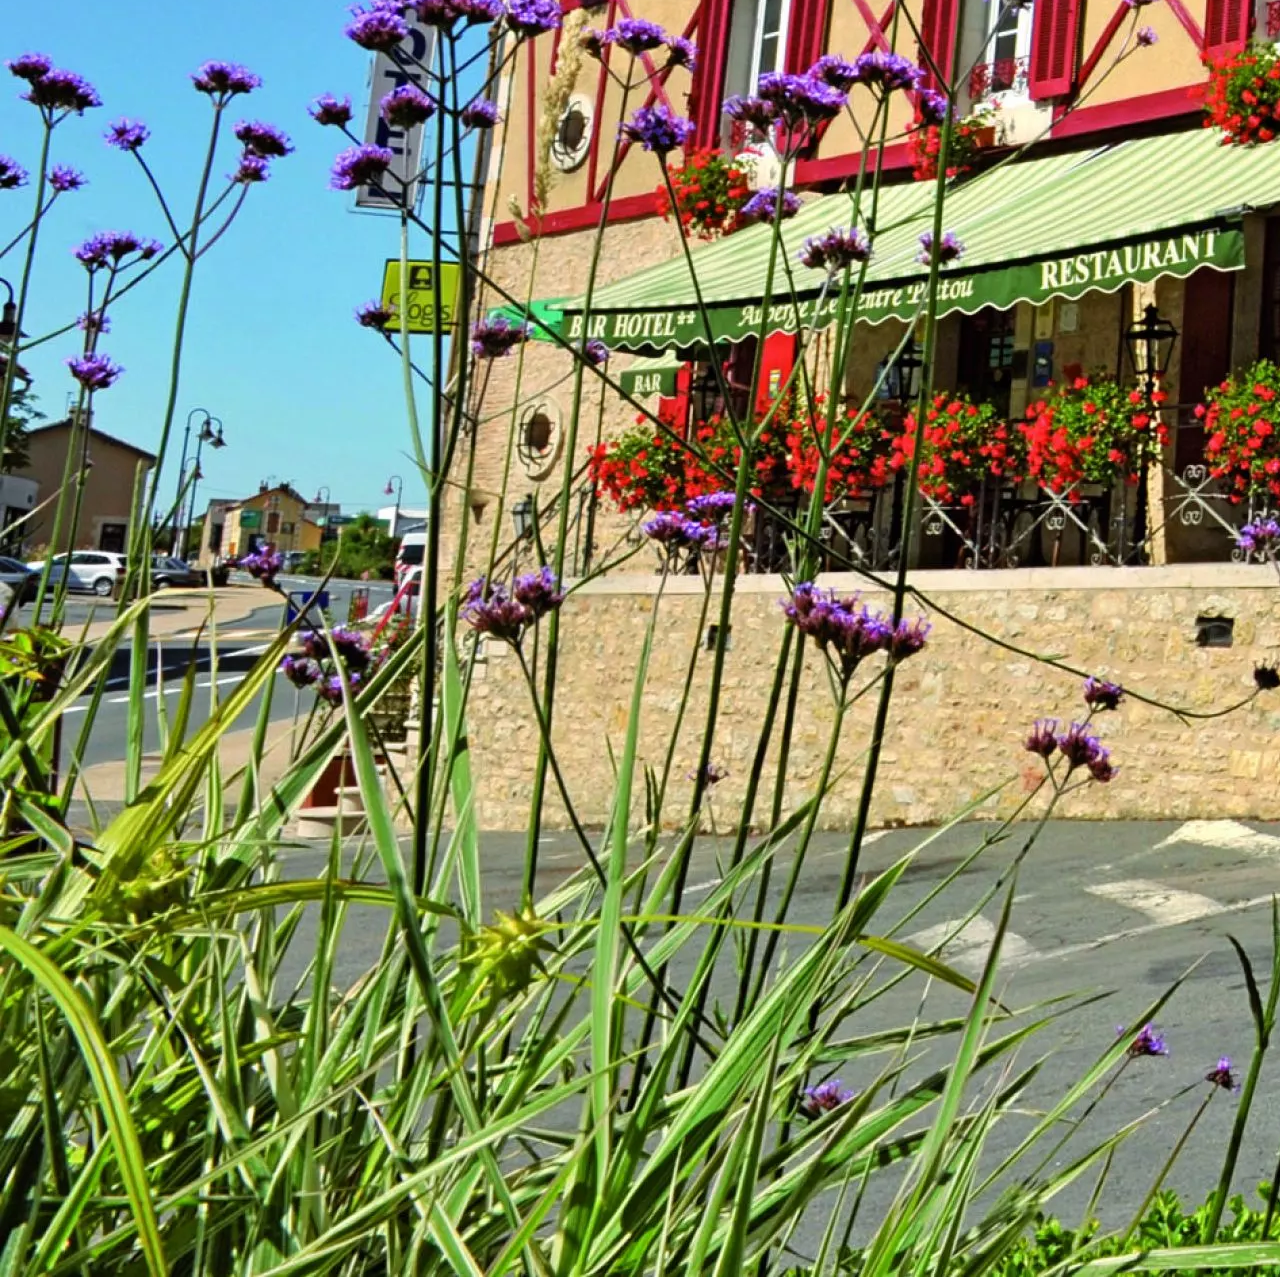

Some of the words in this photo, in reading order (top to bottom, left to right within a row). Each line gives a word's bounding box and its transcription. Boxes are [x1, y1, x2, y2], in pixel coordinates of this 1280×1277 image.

[1040, 228, 1220, 289] RESTAURANT
[388, 292, 450, 327] Logs
[843, 285, 902, 312] entre
[907, 278, 974, 309] Ptou
[633, 373, 662, 393] BAR
